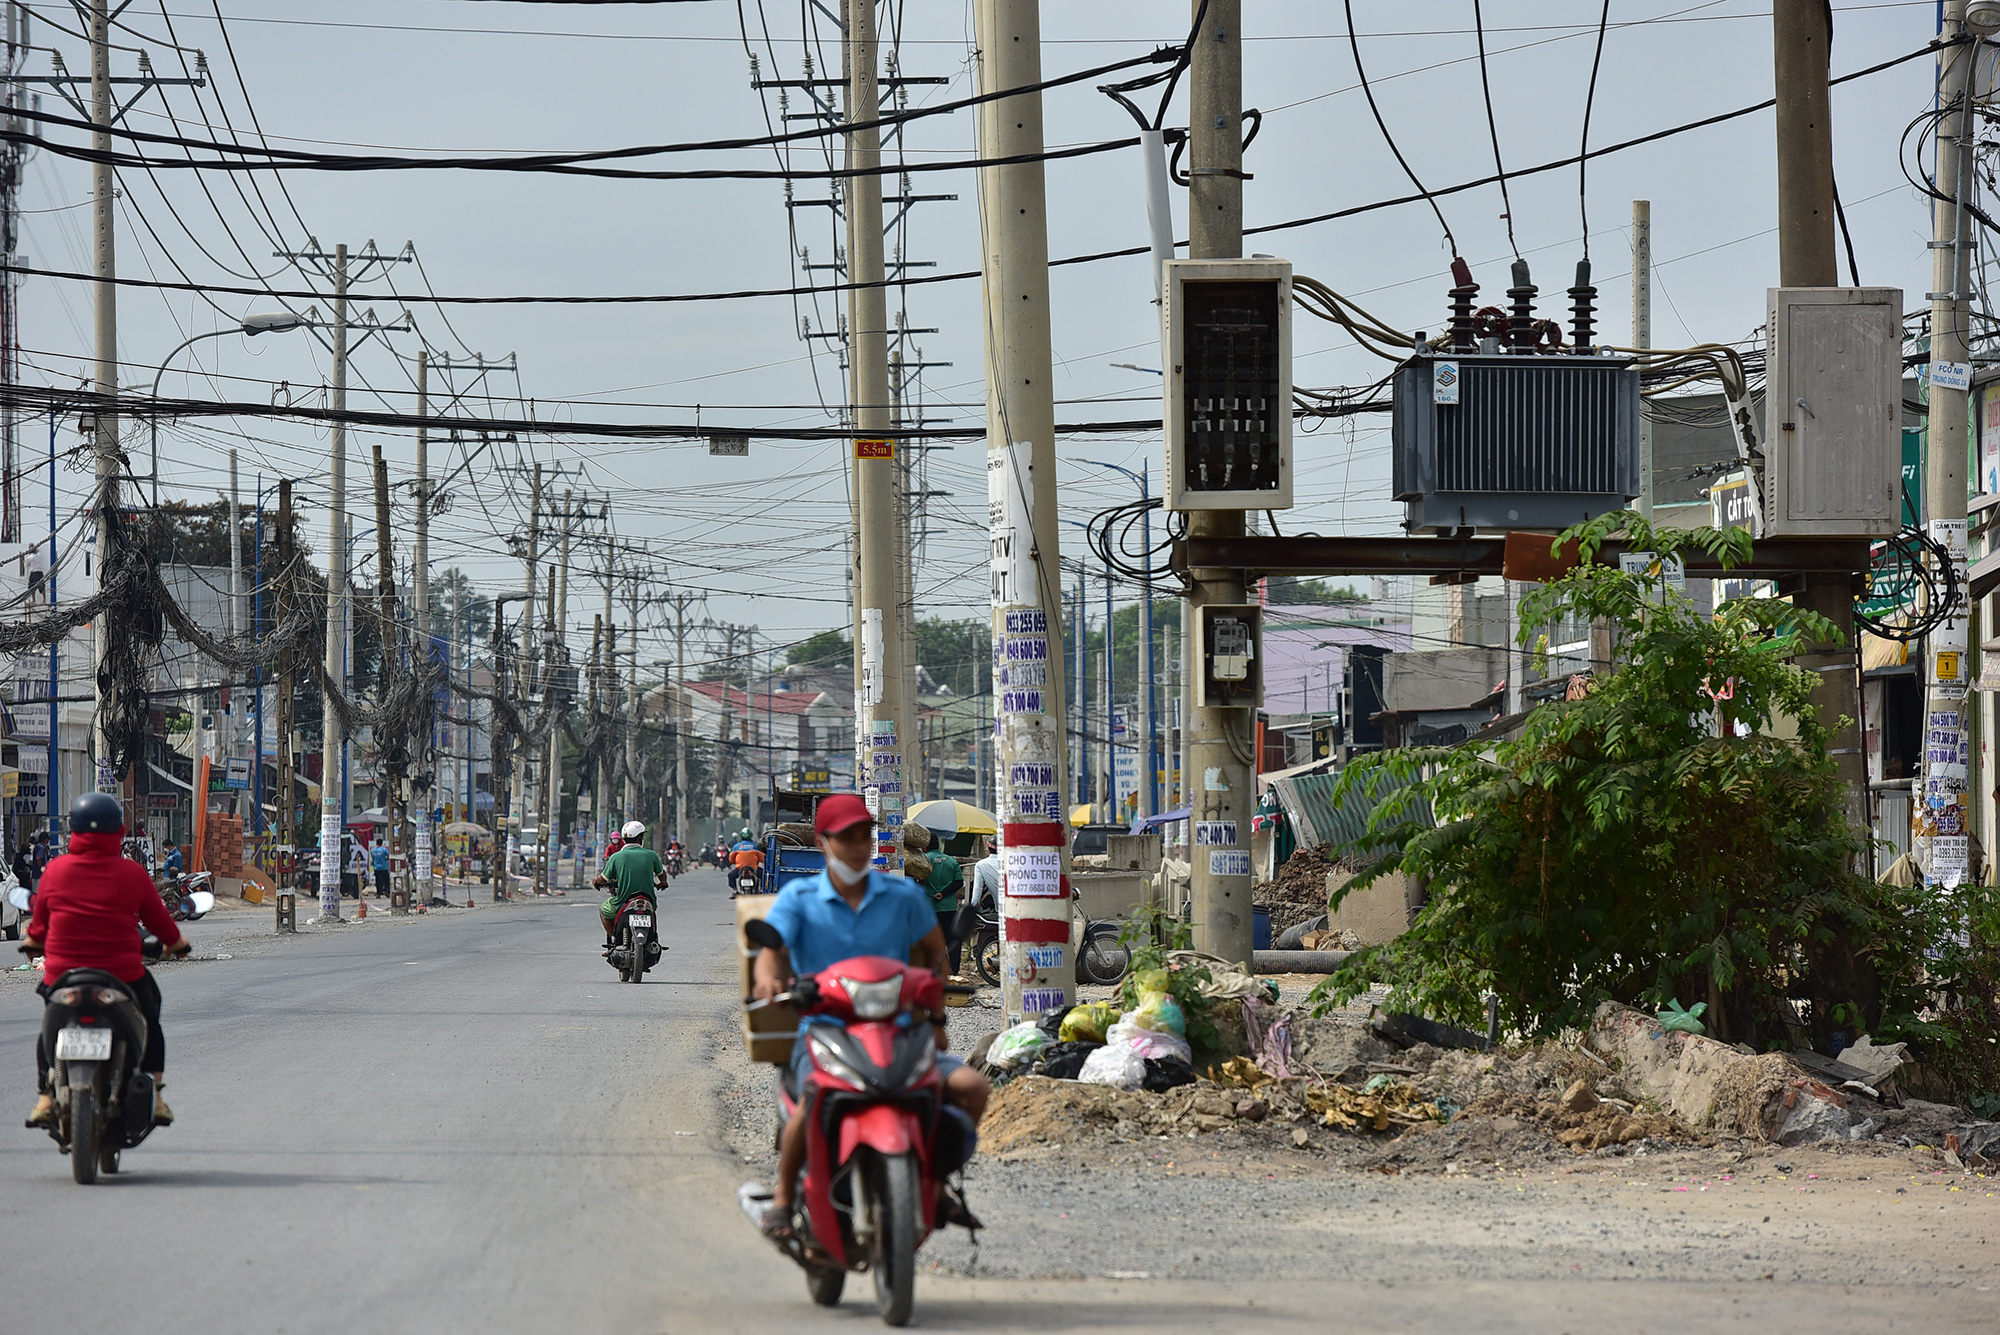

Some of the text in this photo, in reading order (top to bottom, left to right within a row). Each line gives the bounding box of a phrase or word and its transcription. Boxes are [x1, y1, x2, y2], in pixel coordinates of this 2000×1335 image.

[1939, 365, 1952, 373] FCO
[863, 445, 887, 454] 5.5m
[1945, 662, 1949, 670] 1
[1009, 854, 1058, 865] CHO THUÊ
[1008, 868, 1058, 882] PHÒNG TRỌ
